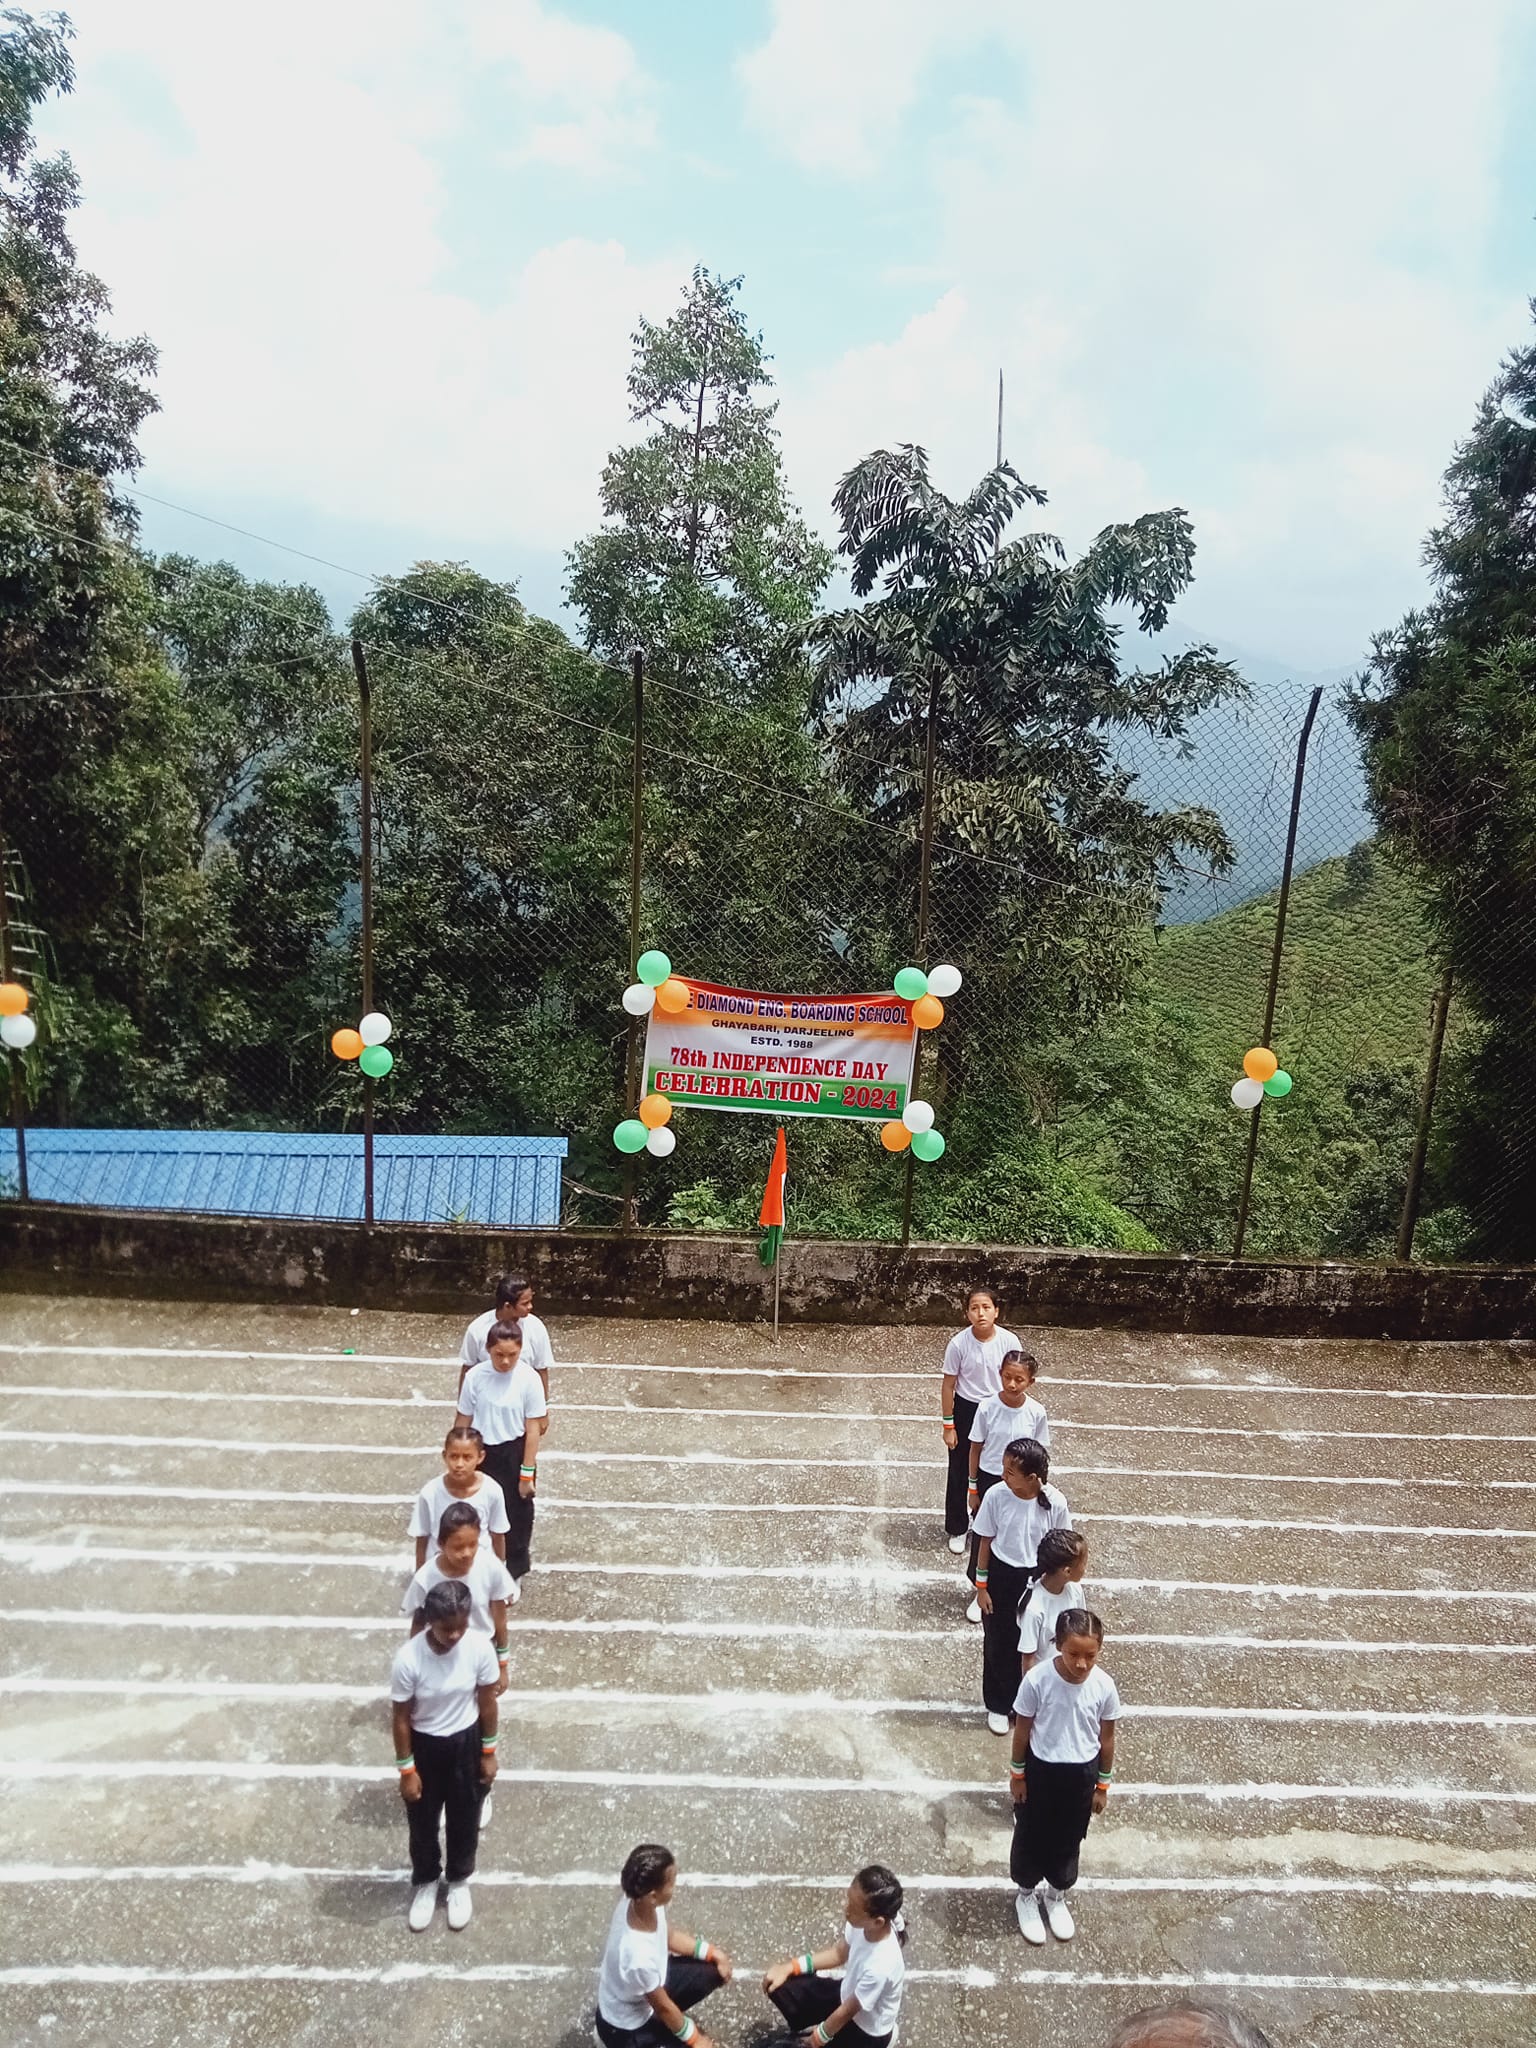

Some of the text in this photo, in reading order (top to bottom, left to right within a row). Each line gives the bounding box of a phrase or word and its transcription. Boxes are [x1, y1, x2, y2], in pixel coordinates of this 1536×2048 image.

[697, 993, 755, 1014] DIAMOND
[758, 1000, 787, 1018] ENG.
[791, 1002, 855, 1022] BOARDING
[858, 1006, 908, 1025] SCHOOL
[711, 1019, 855, 1037] GHAYABARI, DARJEELING
[750, 1036, 814, 1049] ESTD. 1988
[671, 1047, 889, 1081] 78th INDEPENDENCE DAY
[655, 1071, 822, 1103] CELEBRATION
[842, 1085, 898, 1110] 2024
